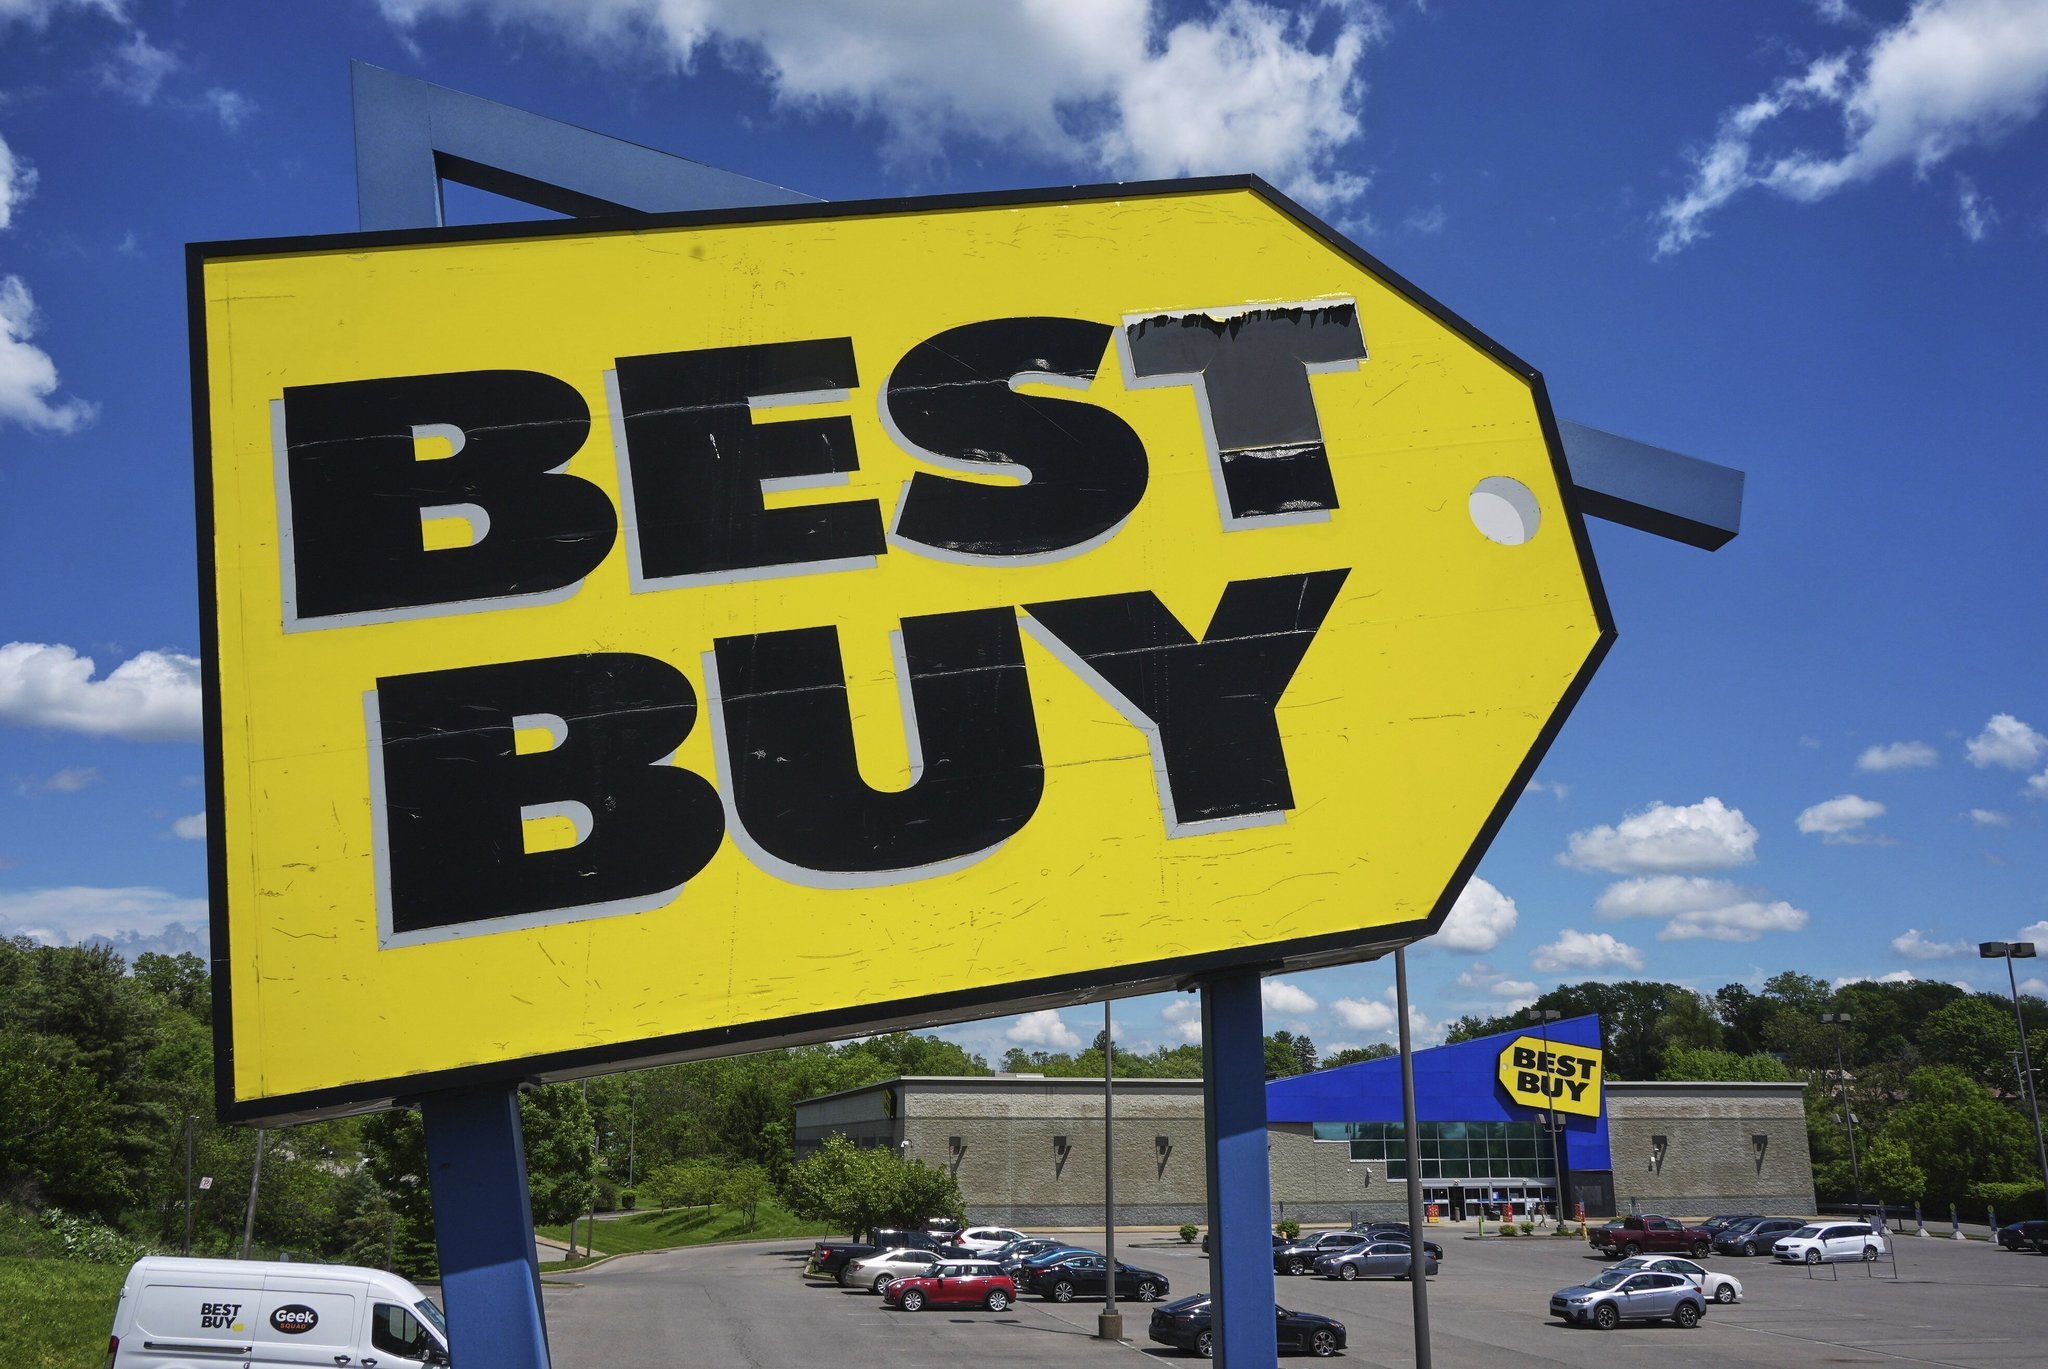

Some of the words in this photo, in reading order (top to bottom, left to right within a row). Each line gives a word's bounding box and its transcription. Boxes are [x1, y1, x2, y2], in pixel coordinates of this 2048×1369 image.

[271, 298, 1367, 633] BEST
[364, 567, 1351, 951] BUY
[1513, 1047, 1596, 1080] BEST
[1517, 1071, 1589, 1102] BUY
[201, 1303, 242, 1316] BEST
[201, 1316, 236, 1328] BUY
[276, 1310, 314, 1323] Geek
